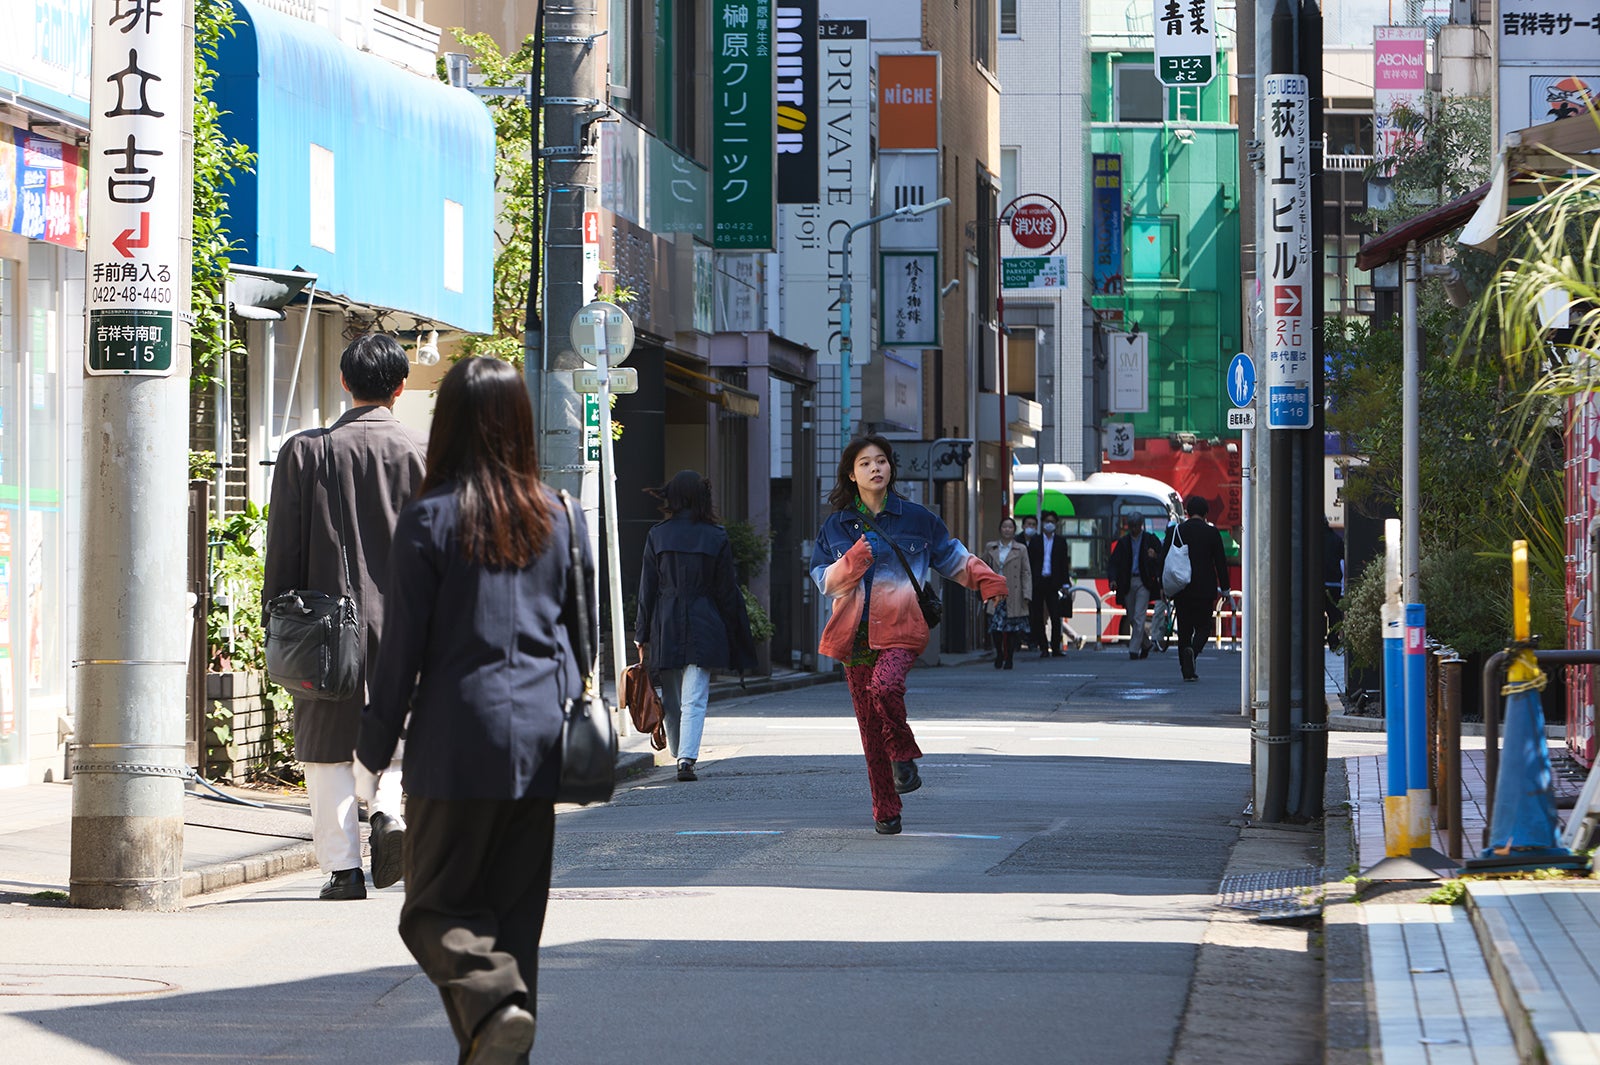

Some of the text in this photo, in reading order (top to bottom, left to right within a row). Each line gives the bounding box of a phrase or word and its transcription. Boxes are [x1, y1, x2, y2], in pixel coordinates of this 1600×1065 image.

[1168, 59, 1203, 69] コピス
[1377, 54, 1424, 66] ABCNail
[1175, 71, 1198, 82] よこ
[827, 46, 853, 205] PRIVATE
[1271, 99, 1298, 280] 荻上ビル
[1015, 217, 1054, 235] 消火栓
[717, 234, 767, 242] 48-6311
[93, 262, 171, 283] 手前角入る
[1044, 276, 1057, 287] 2F
[93, 286, 171, 303] 0422-48-4450
[1276, 319, 1301, 333] 2F
[97, 325, 163, 342] 吉祥寺南町
[1275, 333, 1302, 347] 入口
[104, 345, 155, 362] 1-15
[1279, 363, 1299, 374] 1F
[1273, 407, 1304, 417] 1-16
